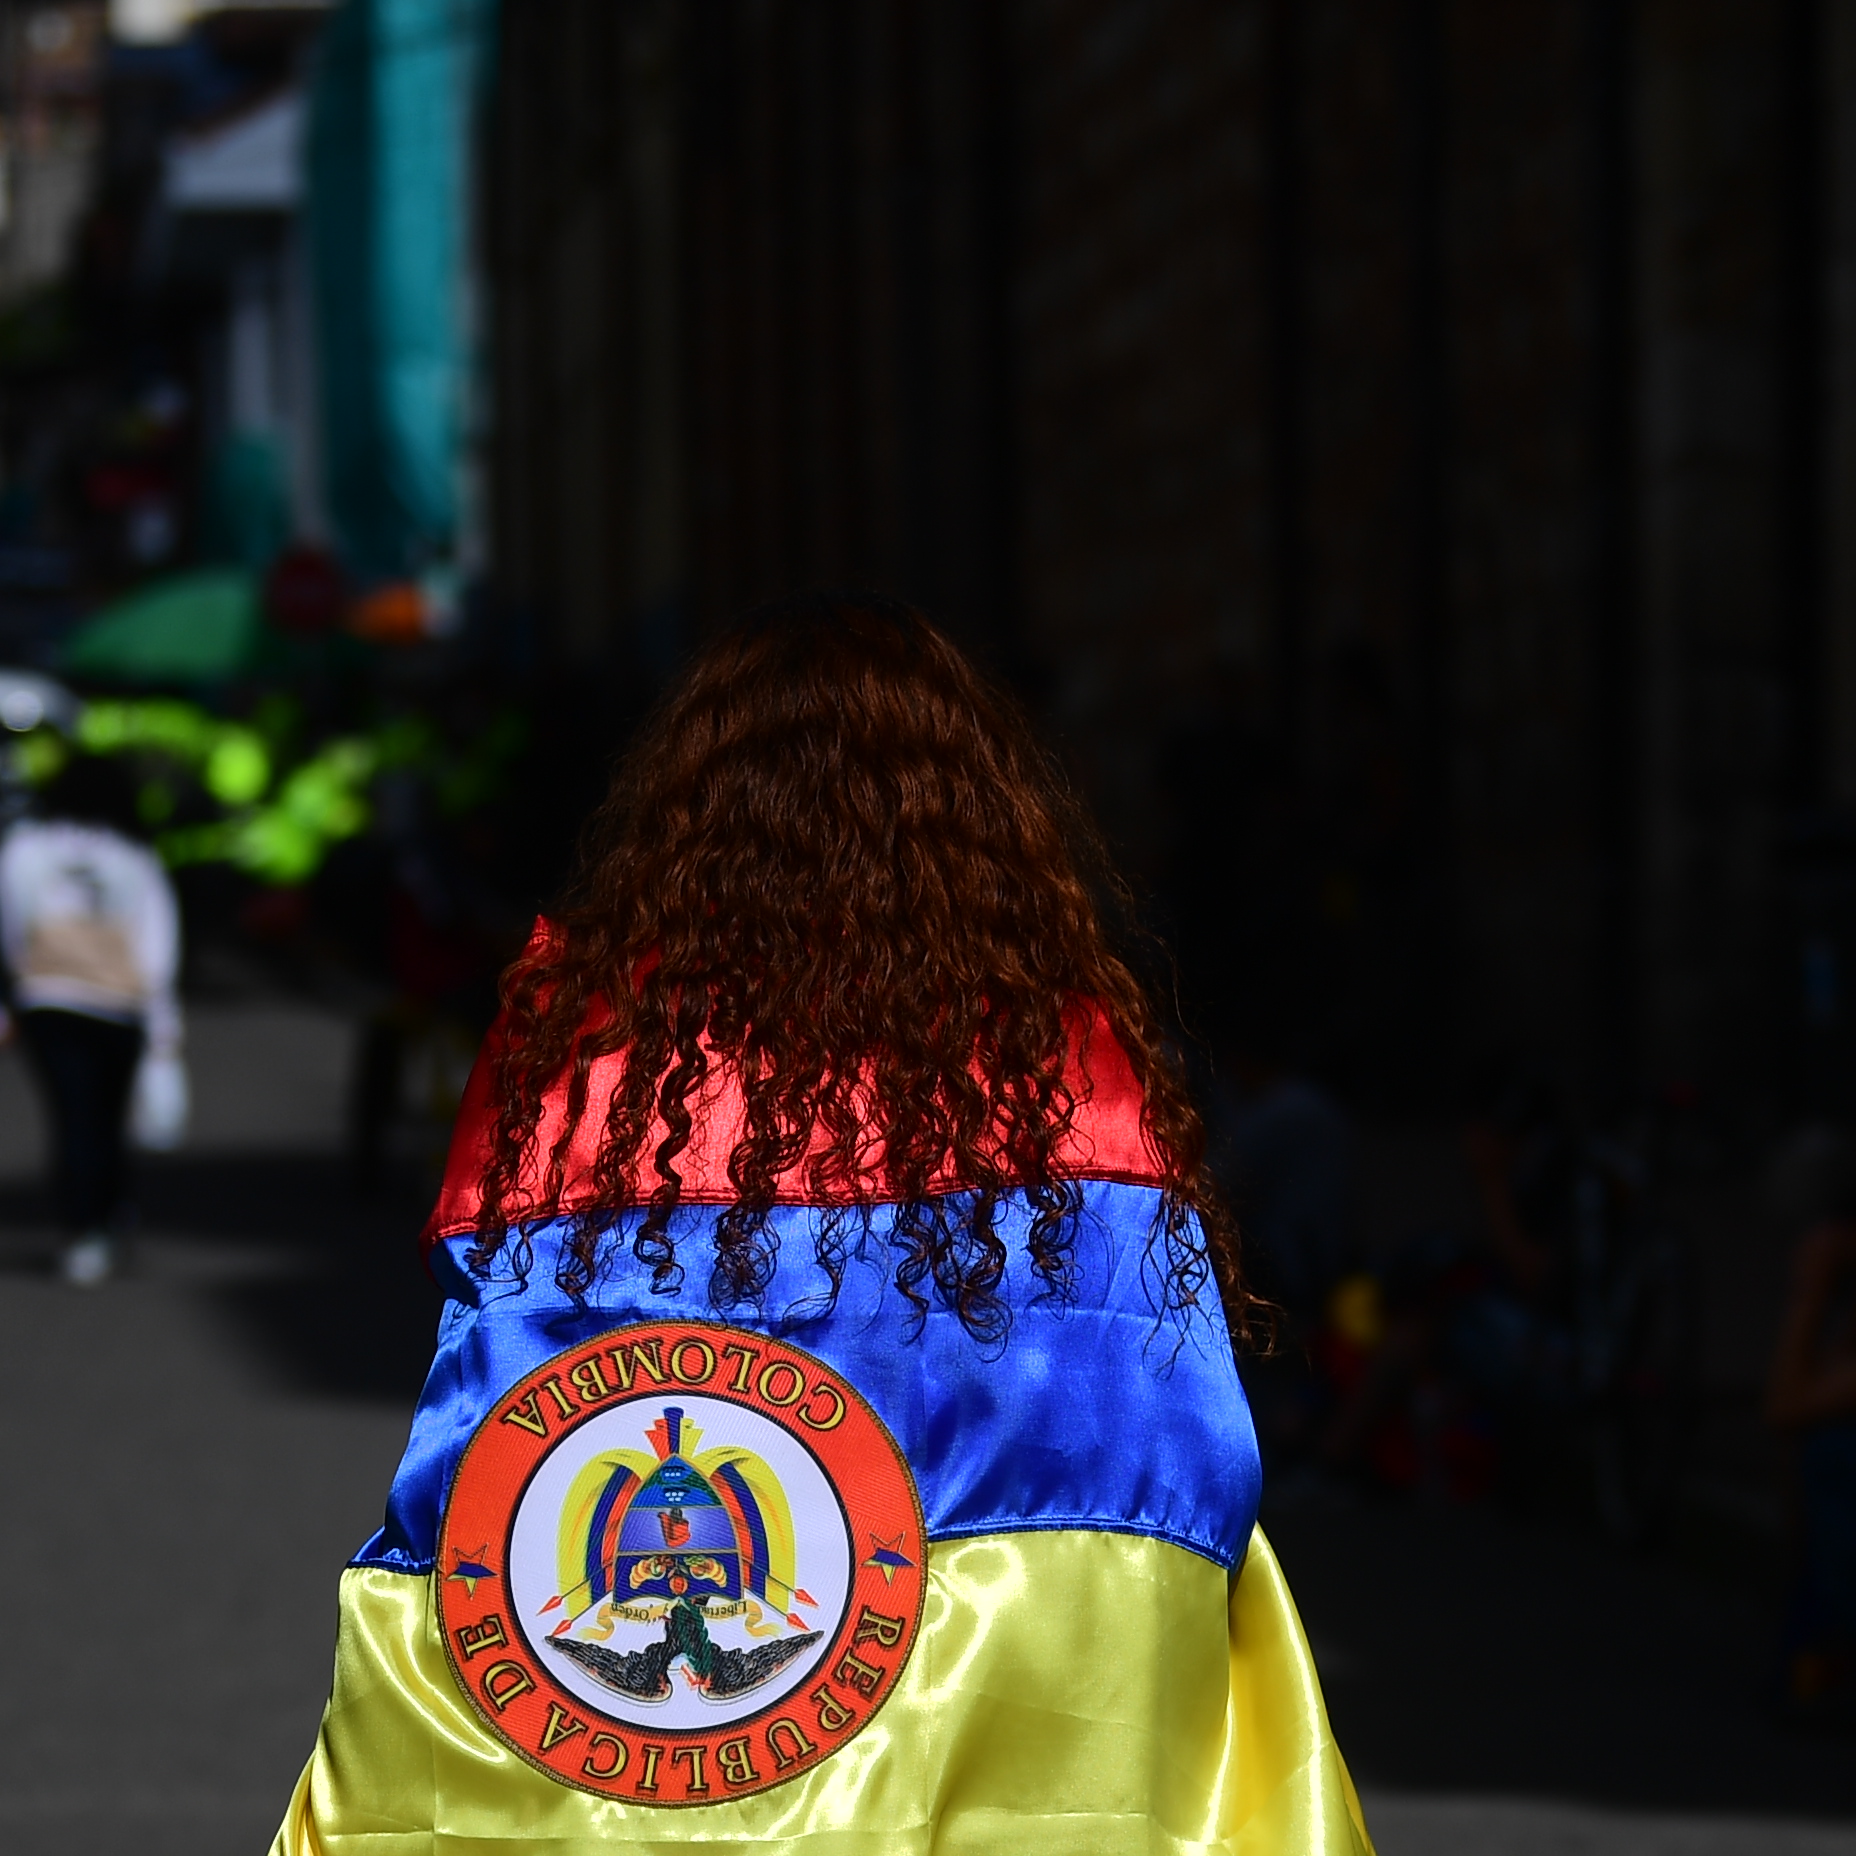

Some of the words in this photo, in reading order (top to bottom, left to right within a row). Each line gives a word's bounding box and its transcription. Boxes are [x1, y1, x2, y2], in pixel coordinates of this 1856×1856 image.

[502, 1337, 847, 1438] COLOMBIA
[610, 1602, 650, 1621] Orden
[459, 1613, 539, 1712] DE
[536, 1605, 905, 1793] REPUBLICA
